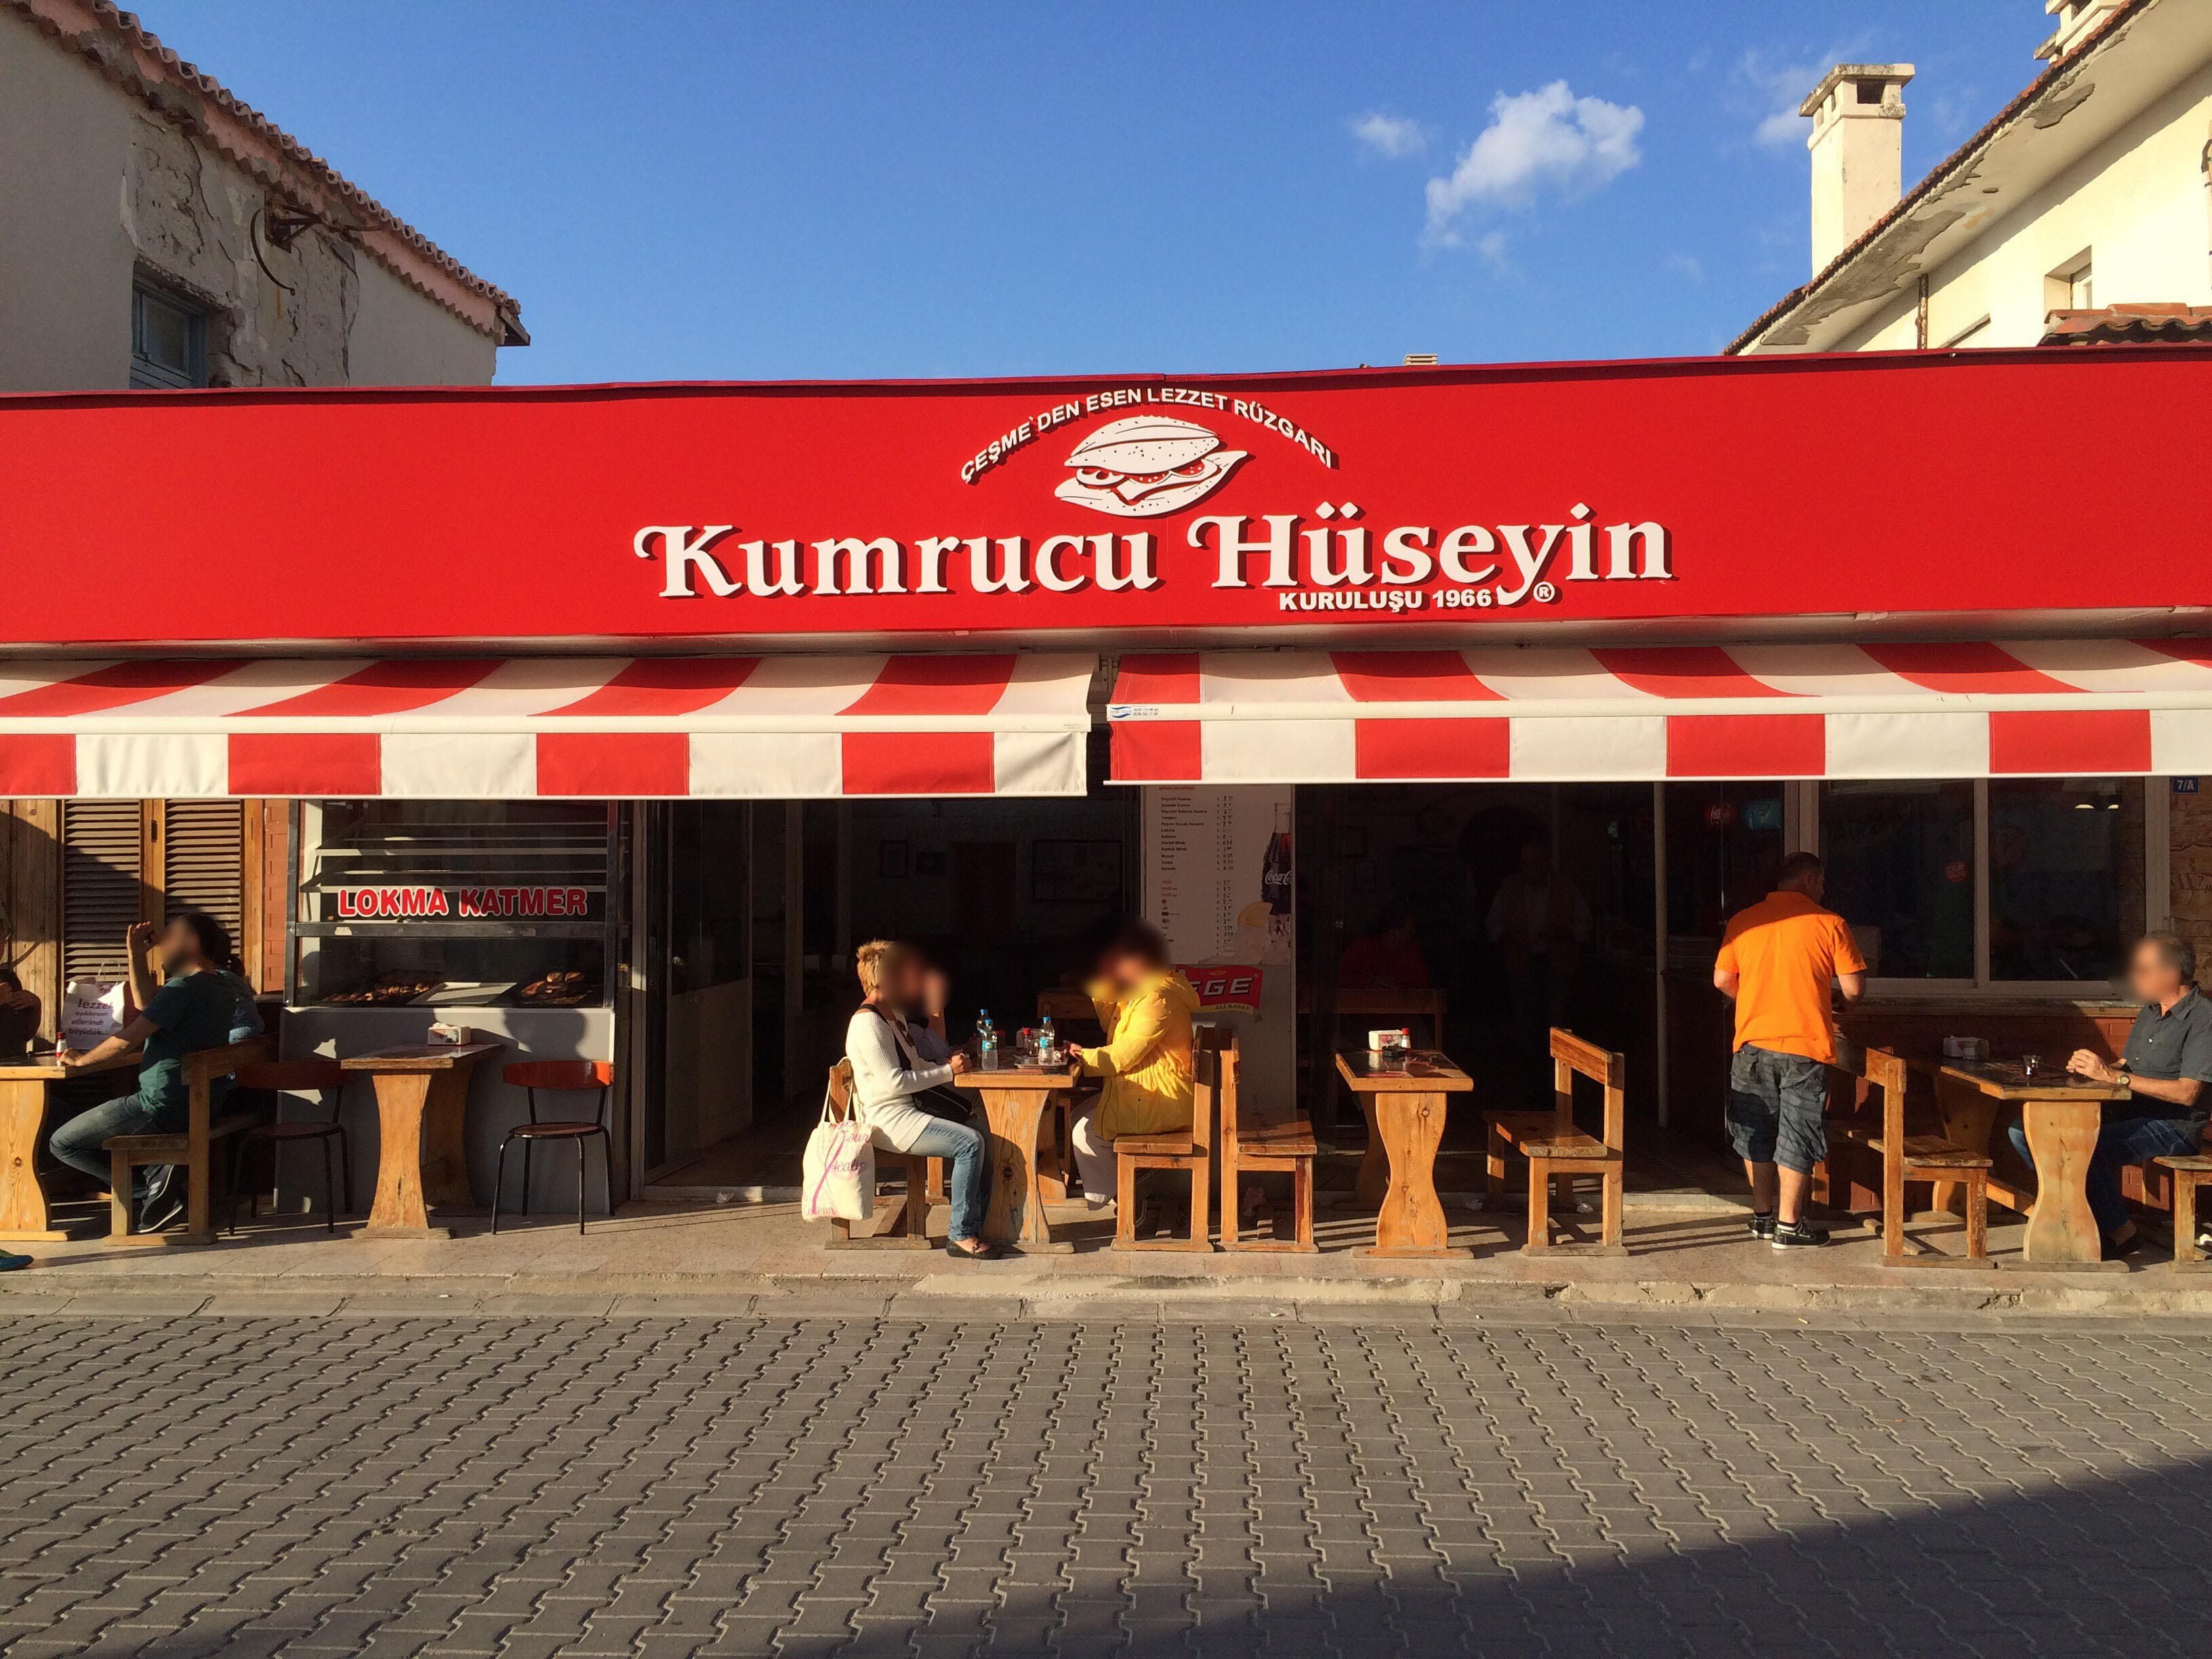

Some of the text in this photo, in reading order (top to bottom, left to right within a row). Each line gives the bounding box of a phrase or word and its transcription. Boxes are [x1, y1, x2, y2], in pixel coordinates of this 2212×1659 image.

[1086, 388, 1142, 412] ESEN
[1147, 387, 1227, 411] LEZZET
[1233, 400, 1332, 469] RÜZGARI
[633, 501, 1673, 605] Kumrucu Hüseyin
[1279, 589, 1491, 613] KURULUŞU 1966
[2176, 779, 2195, 792] 7/A
[337, 886, 588, 917] LOKMA KATMER
